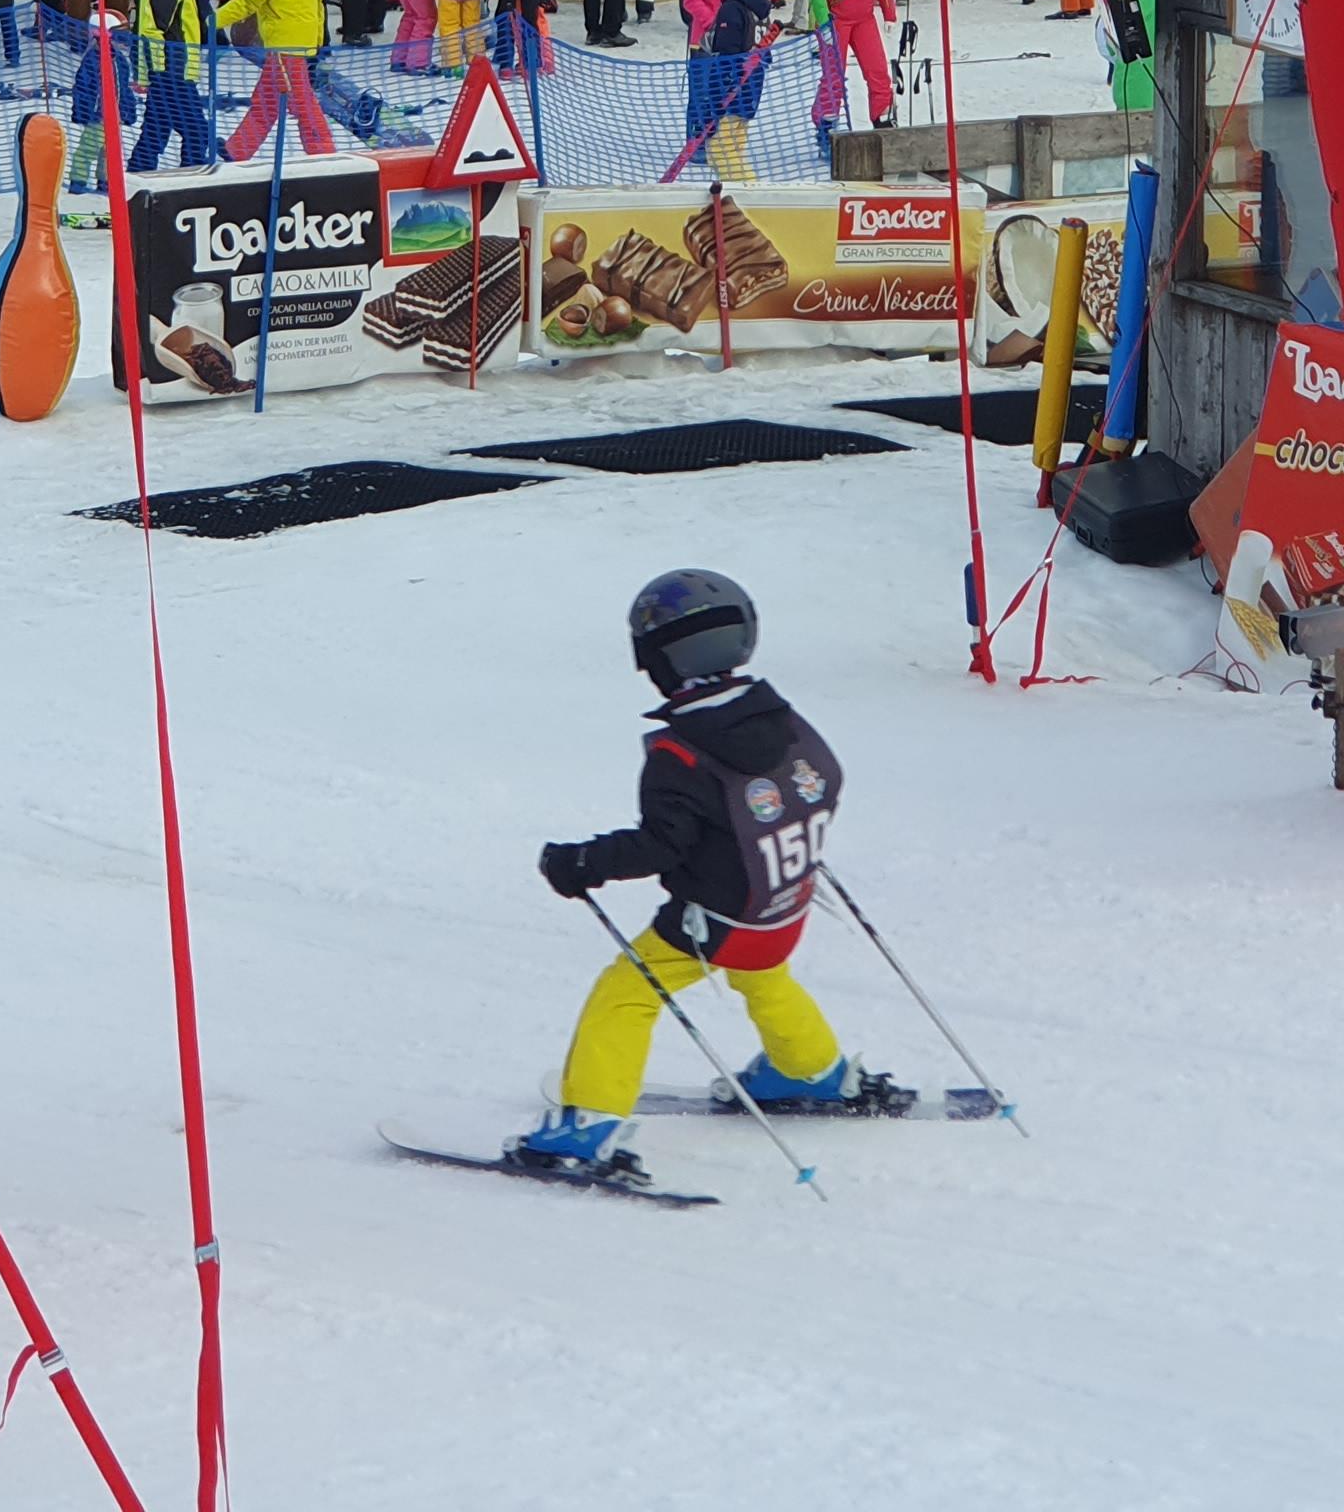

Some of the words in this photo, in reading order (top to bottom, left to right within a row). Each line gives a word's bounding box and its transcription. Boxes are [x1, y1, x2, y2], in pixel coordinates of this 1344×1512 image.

[844, 200, 946, 236] Loacker
[175, 200, 374, 273] Loacker
[842, 247, 874, 259] GRAN
[876, 247, 944, 258] PASTICCERIA
[237, 269, 364, 297] CAAO&MILK
[793, 279, 871, 312] Crème
